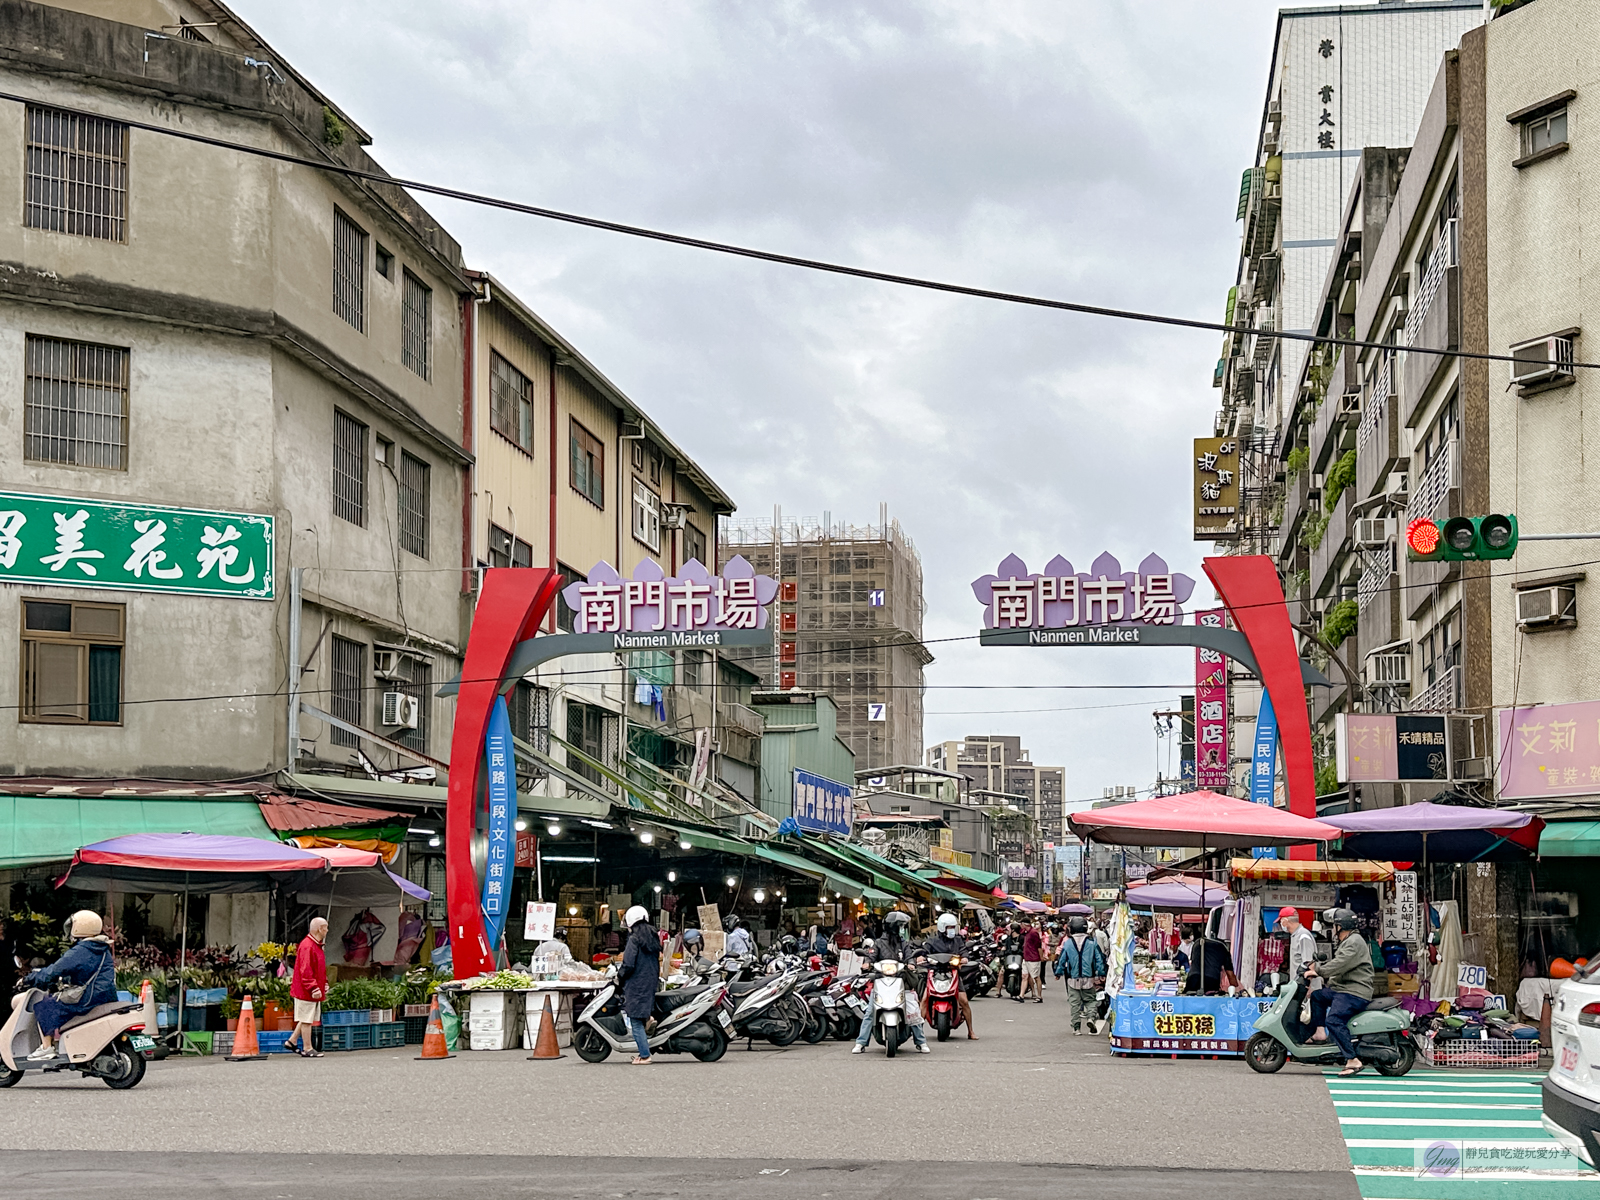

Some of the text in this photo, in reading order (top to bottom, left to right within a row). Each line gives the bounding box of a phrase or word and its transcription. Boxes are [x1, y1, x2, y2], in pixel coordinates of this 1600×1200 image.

[1220, 442, 1236, 453] 6F
[1197, 451, 1234, 500] 波斯貓
[578, 577, 759, 633] 南門市場
[870, 590, 885, 606] 11
[990, 573, 1176, 628] 南門市場
[613, 630, 720, 649] Nanmen Market
[1029, 627, 1140, 644] Nanmen Market
[1198, 668, 1225, 697] KTV
[871, 704, 883, 719] 7
[1200, 700, 1224, 744] 酒店
[1458, 965, 1485, 986] 180
[1150, 1000, 1174, 1013] 彰化
[1155, 1016, 1215, 1035] 社頭襪
